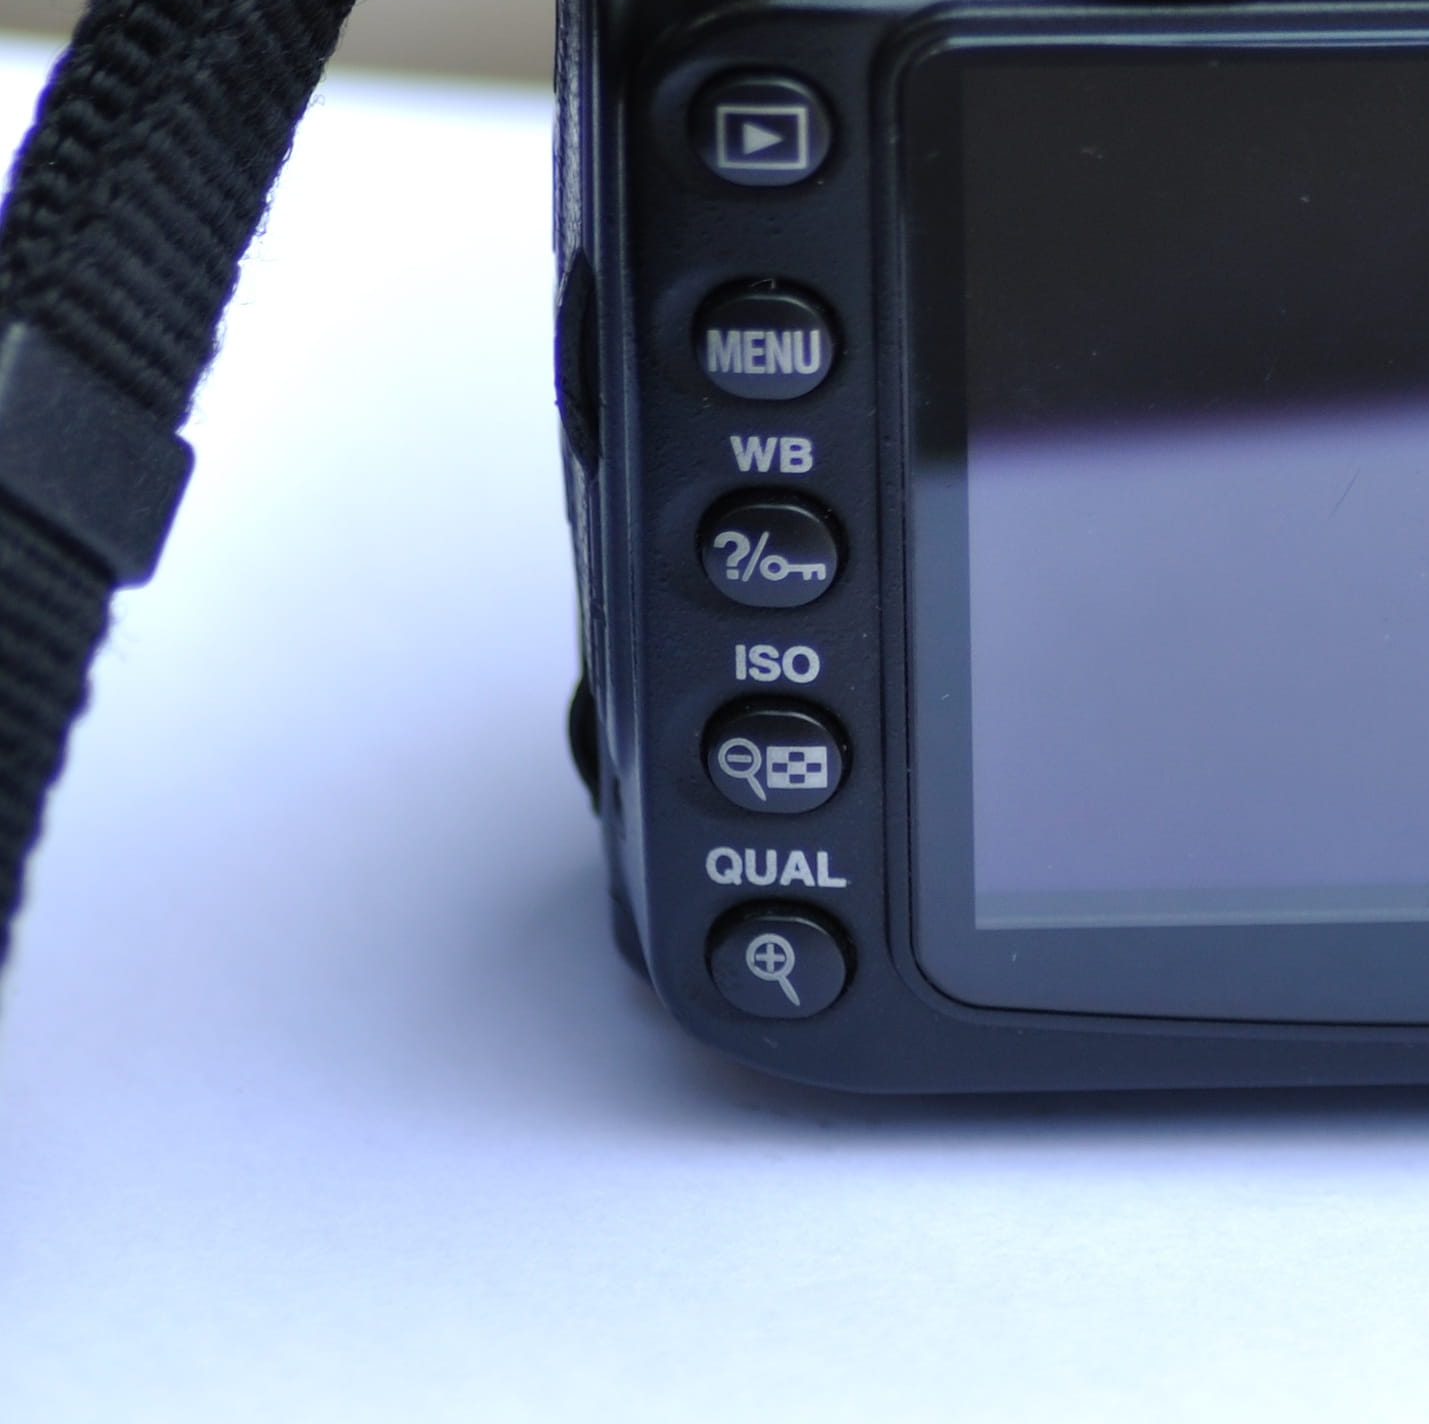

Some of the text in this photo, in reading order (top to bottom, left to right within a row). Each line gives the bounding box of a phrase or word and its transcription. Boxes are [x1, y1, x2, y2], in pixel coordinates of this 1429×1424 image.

[707, 329, 822, 375] MENU
[730, 435, 814, 474] WB
[735, 644, 821, 684] ISO
[705, 846, 848, 888] QUAL
